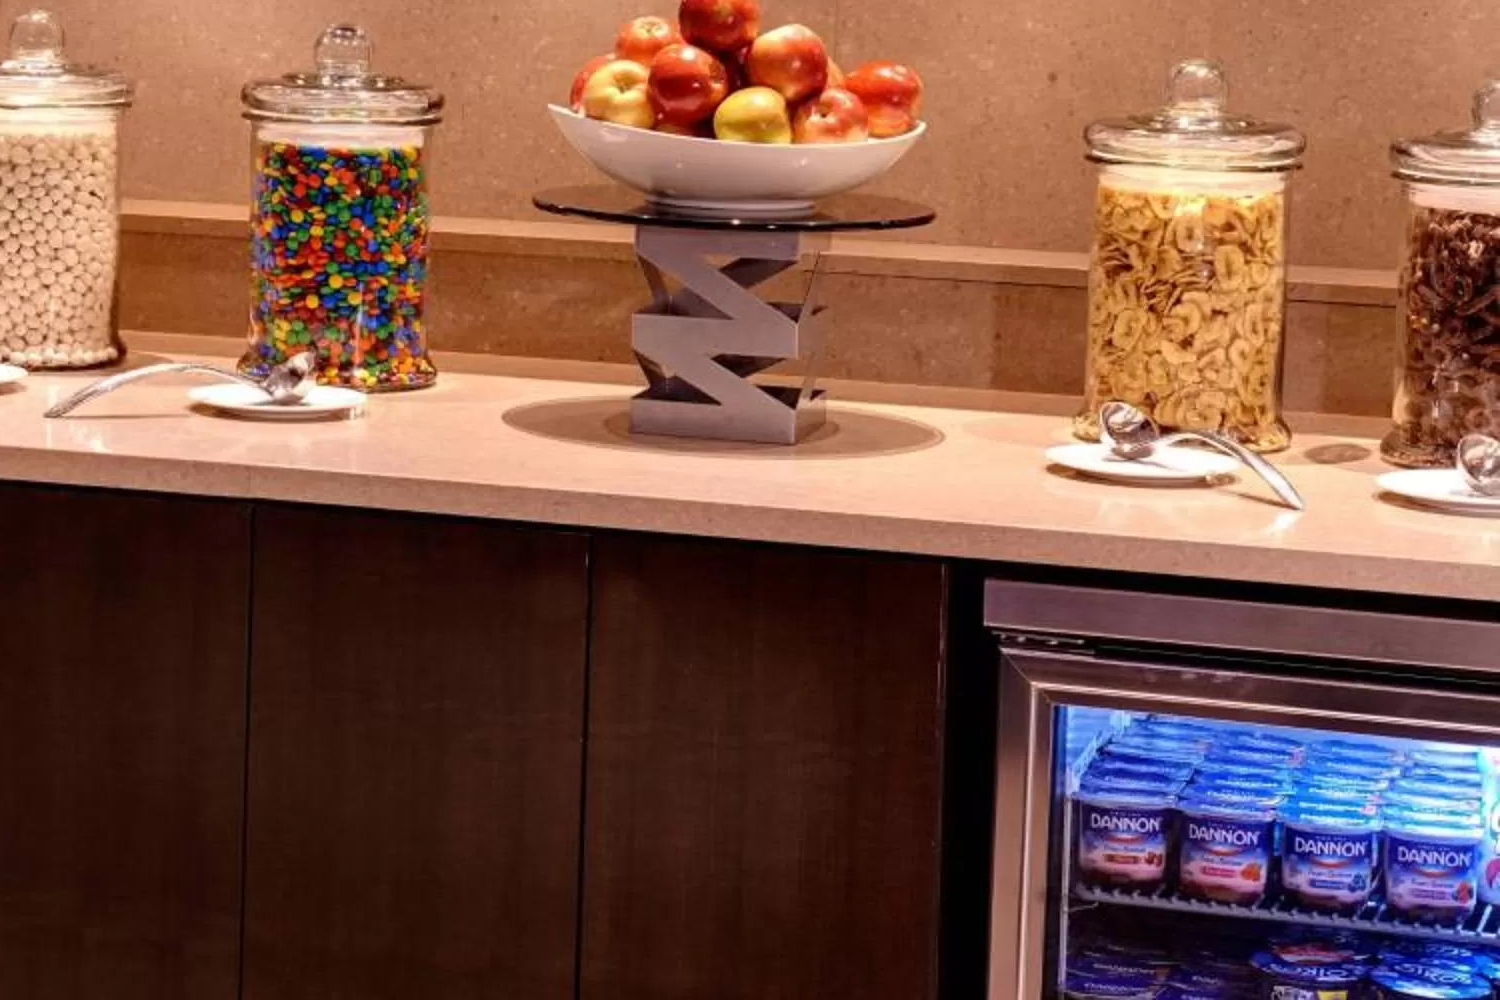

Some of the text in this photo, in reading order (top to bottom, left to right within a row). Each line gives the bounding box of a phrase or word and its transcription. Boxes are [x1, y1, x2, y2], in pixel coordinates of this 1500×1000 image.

[1091, 813, 1162, 833] DANNON
[1189, 822, 1261, 846] DANNON
[1294, 836, 1368, 858] DANNON
[1397, 844, 1473, 868] DANNON
